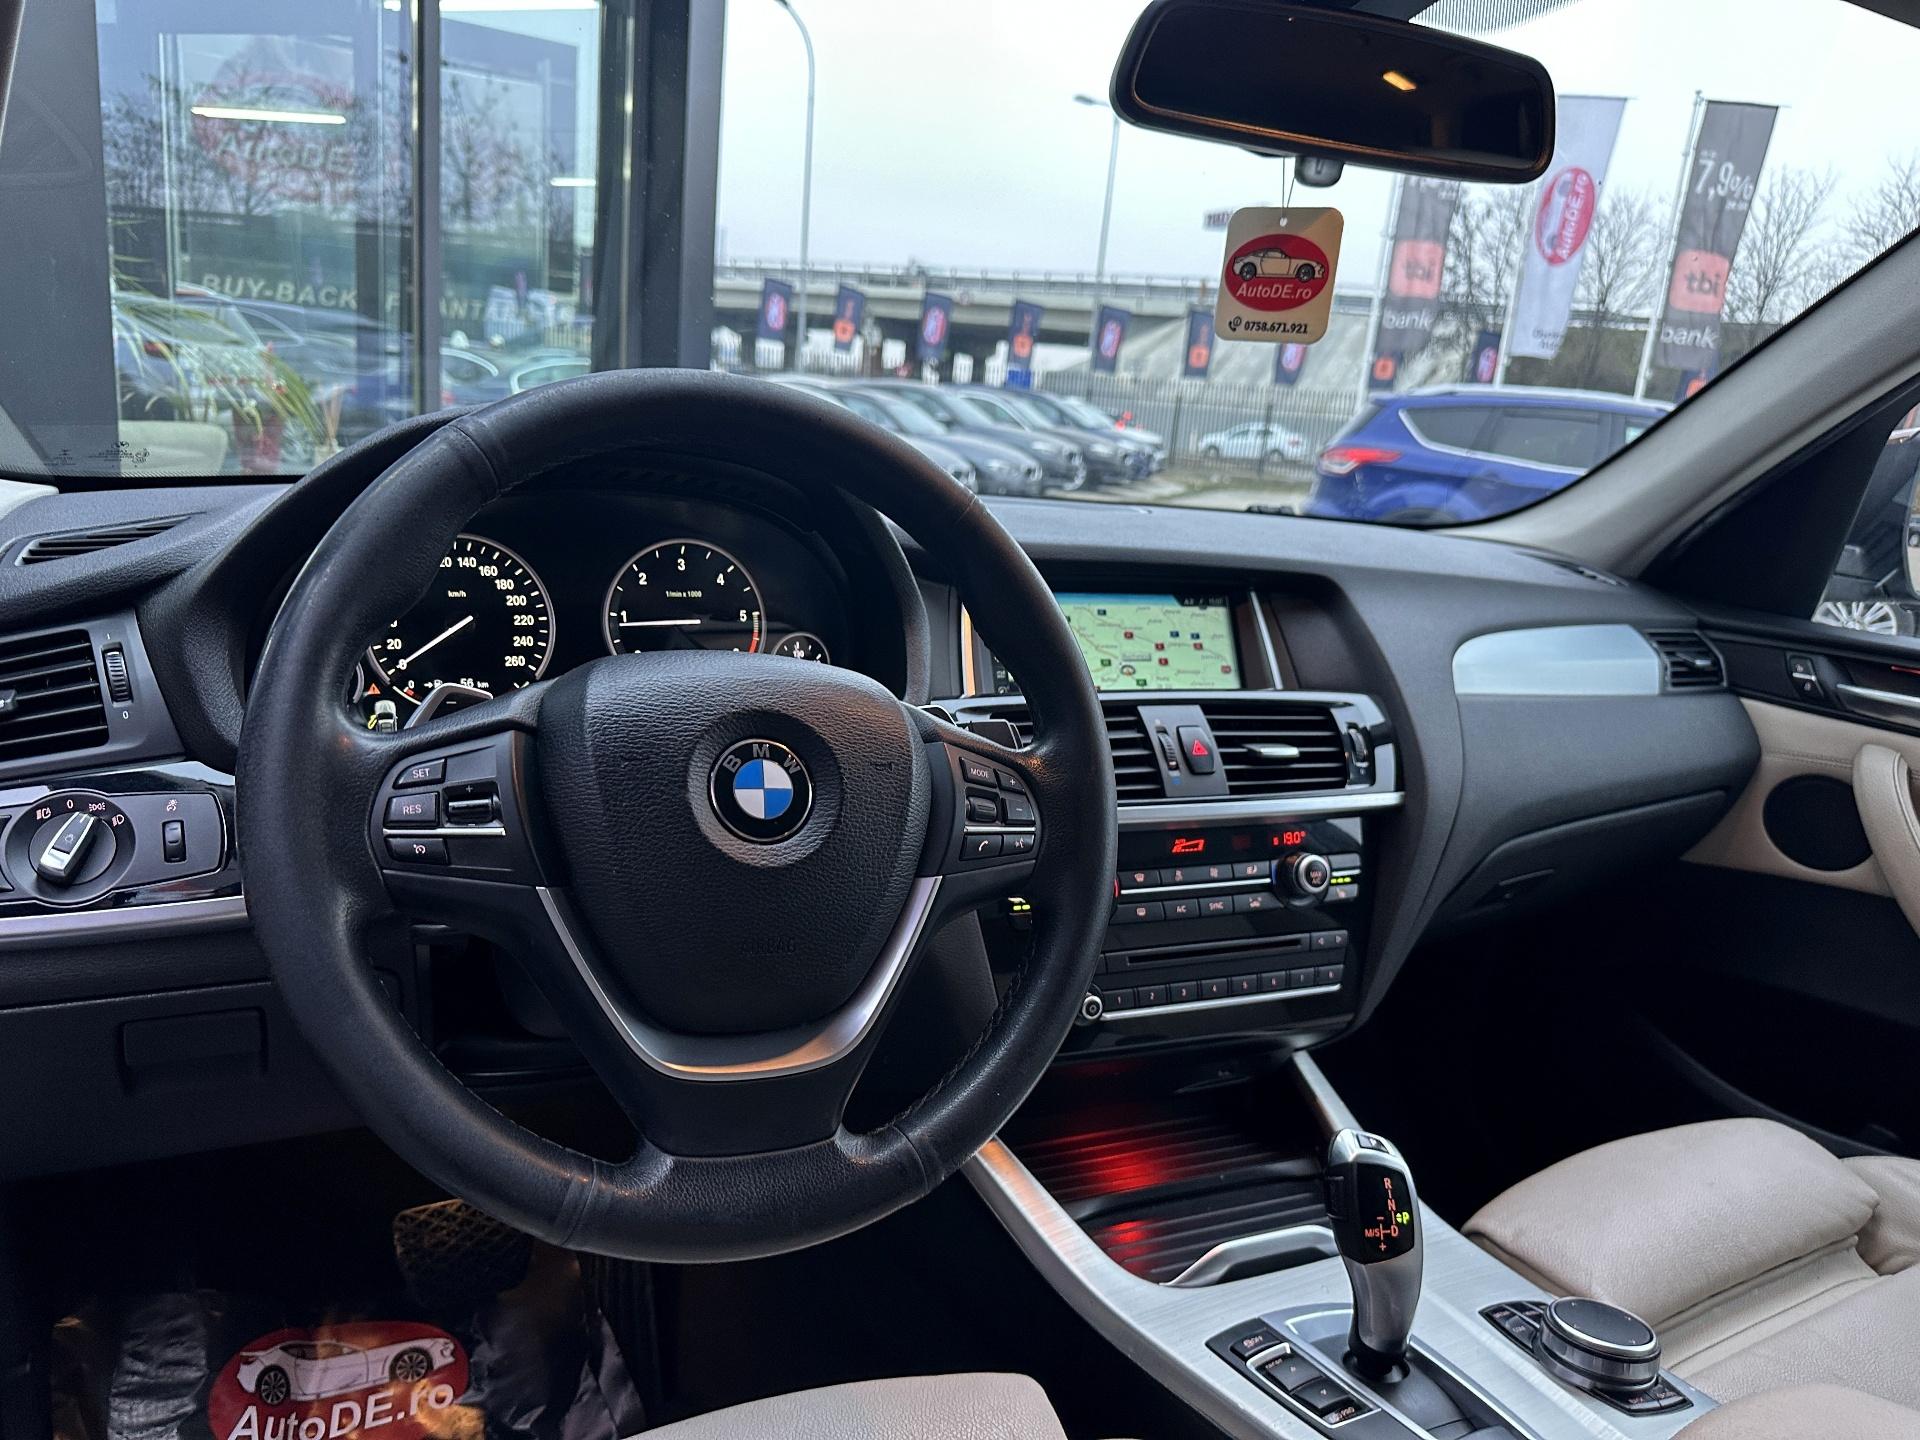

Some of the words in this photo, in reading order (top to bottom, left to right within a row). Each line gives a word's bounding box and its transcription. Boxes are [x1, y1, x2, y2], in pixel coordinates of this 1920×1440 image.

[1685, 269, 1721, 298] tbi
[202, 273, 358, 310] BUY-BACK
[1235, 282, 1312, 299] AutoDE.ro
[1244, 321, 1308, 334] 0758.671.921
[1660, 322, 1719, 350] bank
[457, 556, 477, 568] 140
[677, 558, 686, 571] 3
[478, 565, 499, 577] 160
[494, 579, 515, 590] 180
[638, 572, 648, 586] 2
[716, 573, 725, 586] 4
[447, 590, 467, 598] km/h
[687, 590, 702, 598] 1000
[505, 595, 527, 606] 200
[513, 615, 535, 626] 220
[620, 610, 627, 624] 1
[739, 609, 747, 622] 5
[386, 638, 402, 650] 20
[513, 635, 534, 647] 240
[504, 655, 526, 667] 260
[407, 679, 415, 689] 0
[122, 710, 129, 719] 0
[722, 743, 801, 774] BMW
[412, 768, 430, 779] SET
[67, 799, 74, 809] 0
[403, 804, 422, 815] RES
[1384, 1177, 1392, 1189] R
[1387, 1199, 1396, 1211] N
[1402, 1212, 1410, 1224] P
[1364, 1228, 1380, 1237] M/S
[1390, 1224, 1399, 1237] D
[226, 1383, 454, 1440] AutoDE.ro
